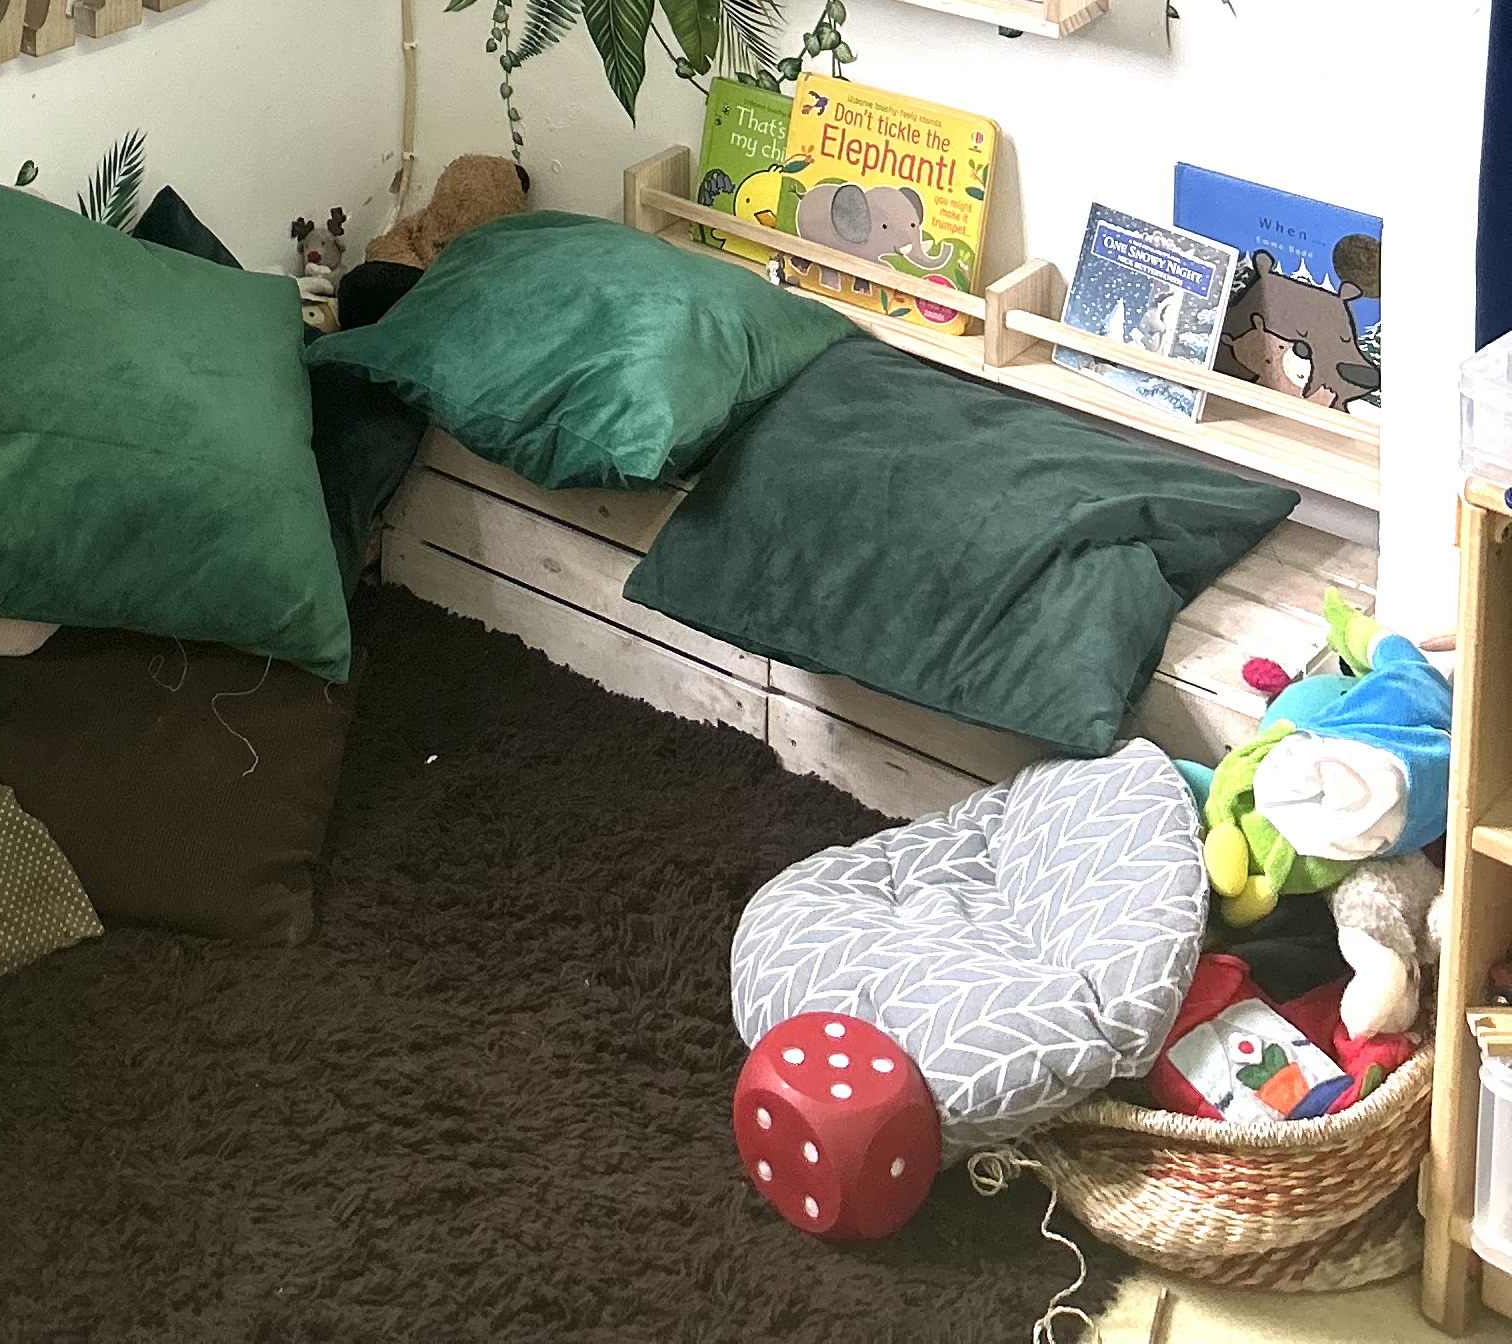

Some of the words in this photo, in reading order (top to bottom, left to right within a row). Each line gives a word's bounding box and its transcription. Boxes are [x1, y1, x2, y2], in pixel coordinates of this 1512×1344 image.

[736, 105, 787, 140] That's
[834, 102, 873, 132] Don't
[877, 116, 921, 145] tickle
[926, 129, 952, 154] the
[918, 114, 942, 128] sounds
[730, 131, 758, 158] my
[820, 122, 957, 194] Elephant!
[1259, 216, 1307, 241] When
[1128, 245, 1167, 269] SNOWY
[1167, 260, 1203, 284] NIGHT
